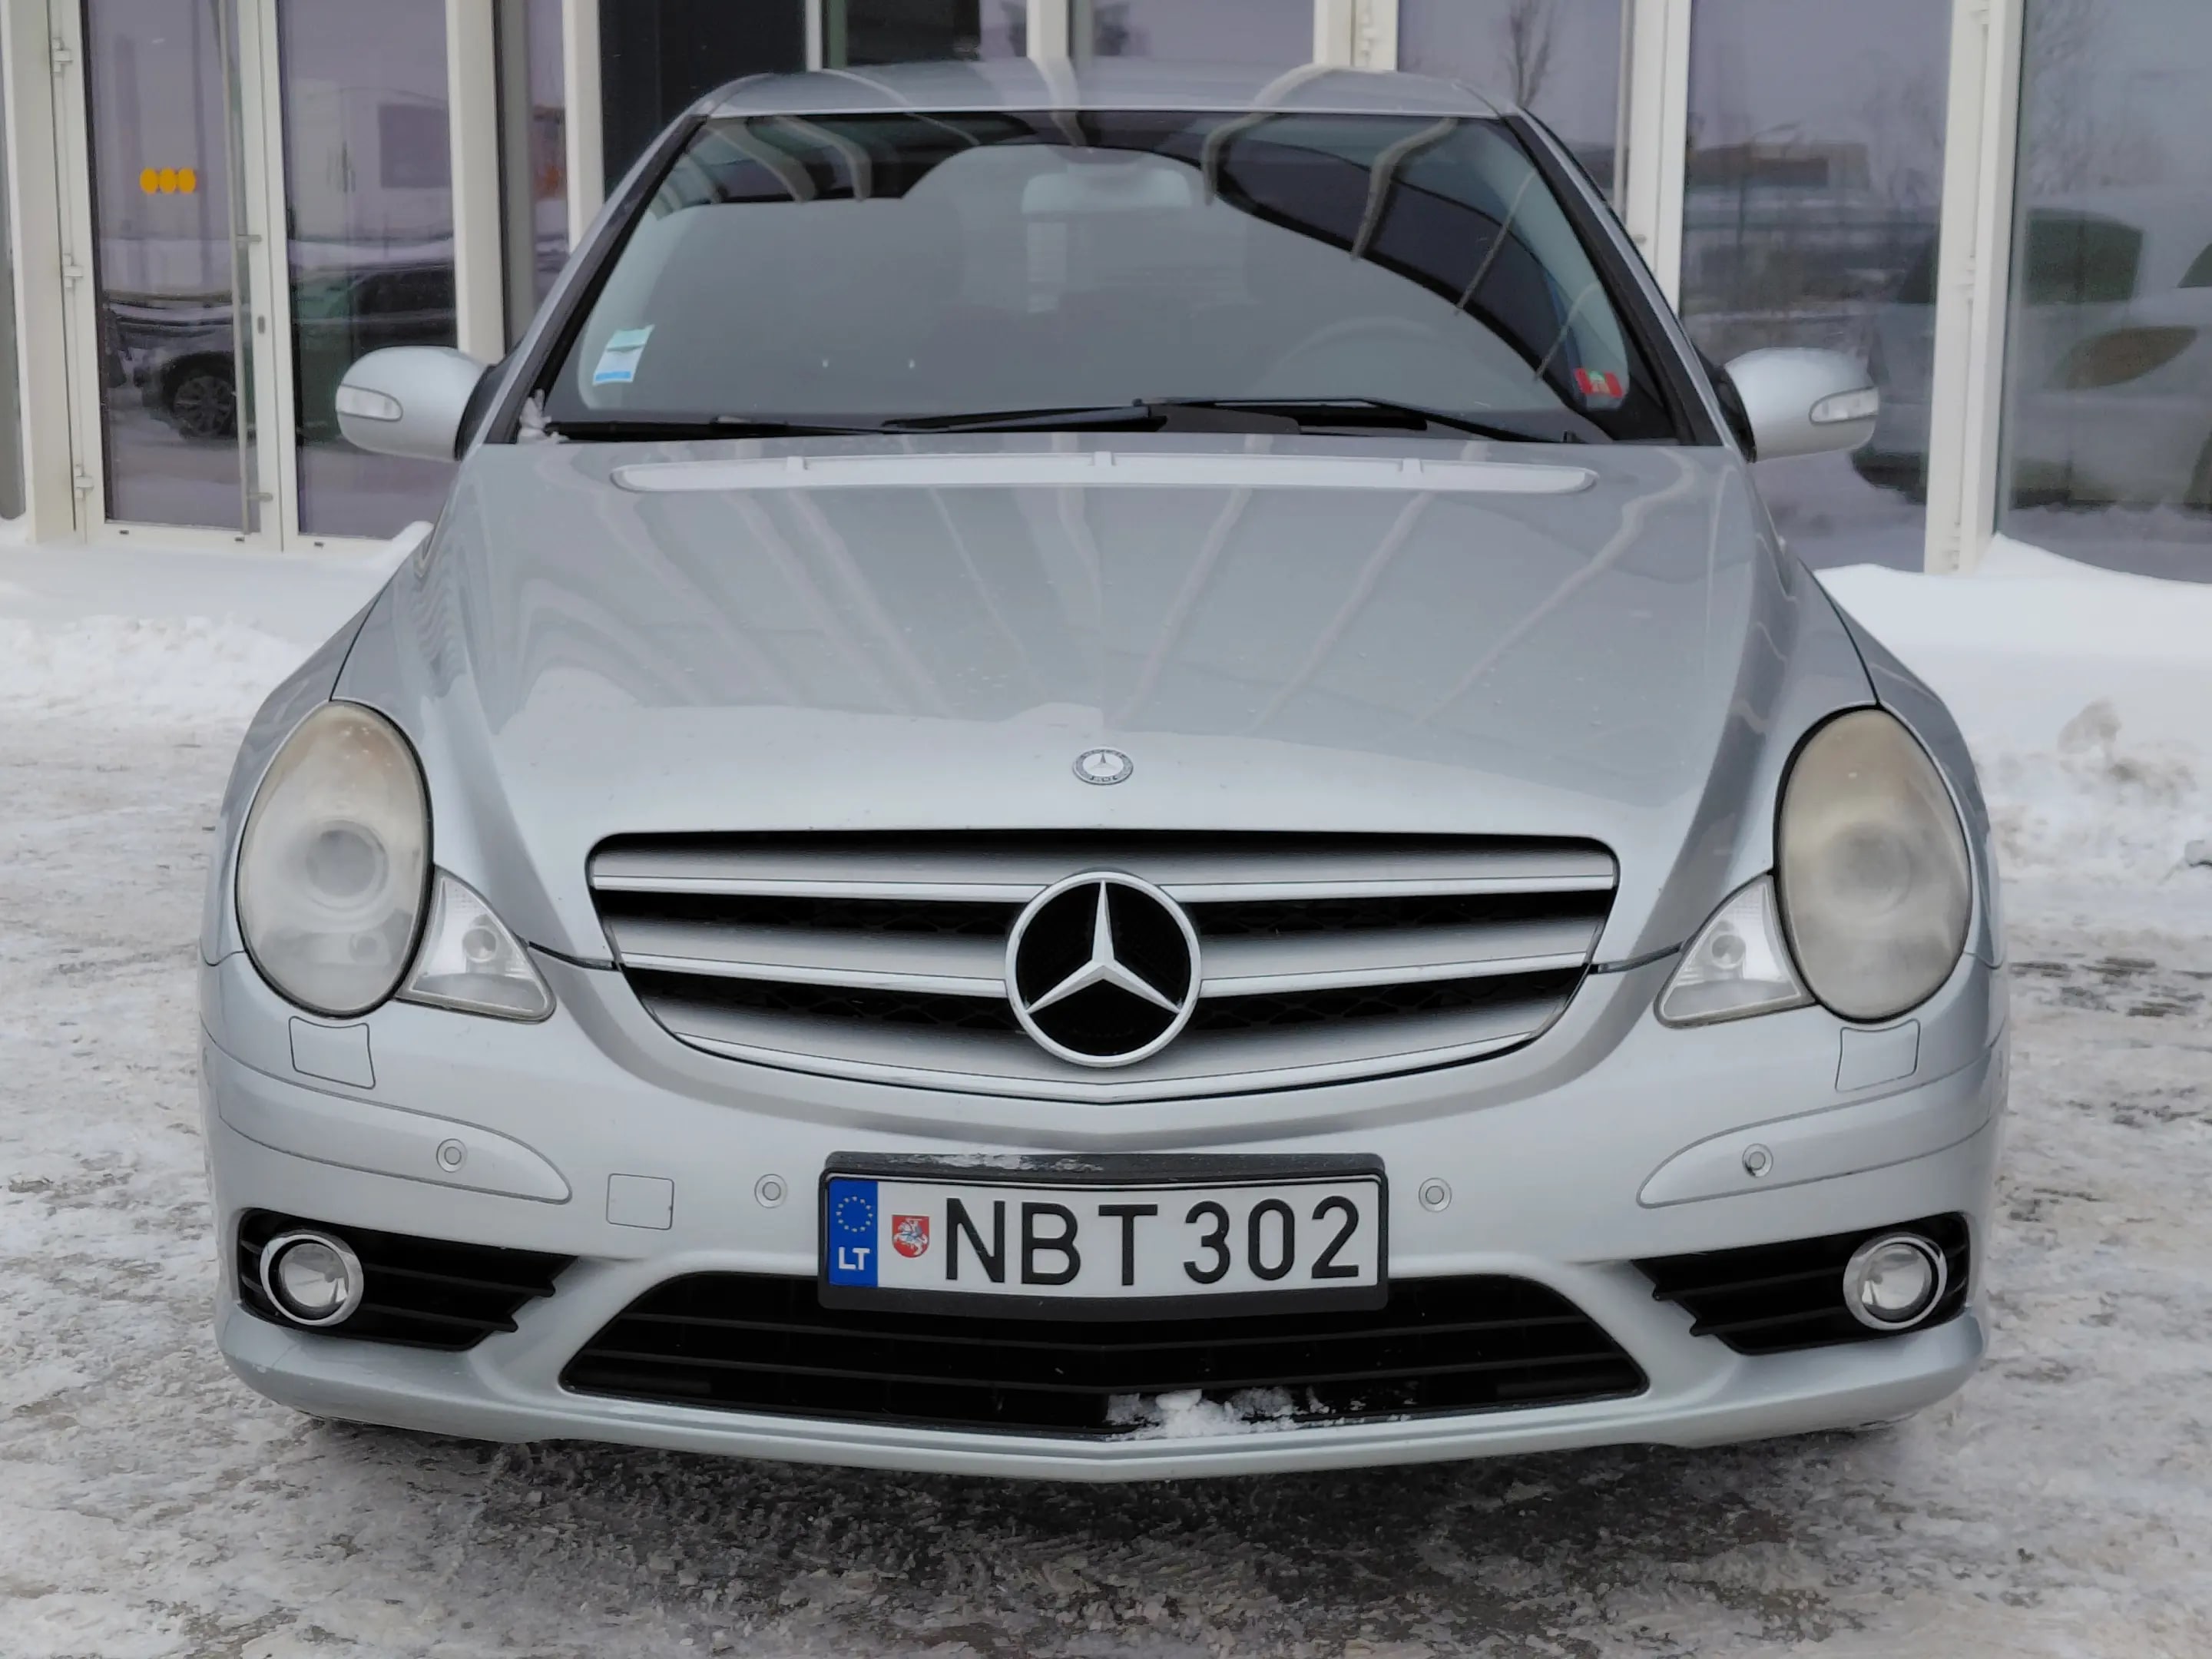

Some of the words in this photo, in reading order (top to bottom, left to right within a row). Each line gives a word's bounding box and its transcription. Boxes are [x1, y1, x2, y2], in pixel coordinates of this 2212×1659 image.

[838, 1247, 870, 1270] LT
[945, 1197, 1158, 1286] NBT
[1184, 1196, 1359, 1284] 302
